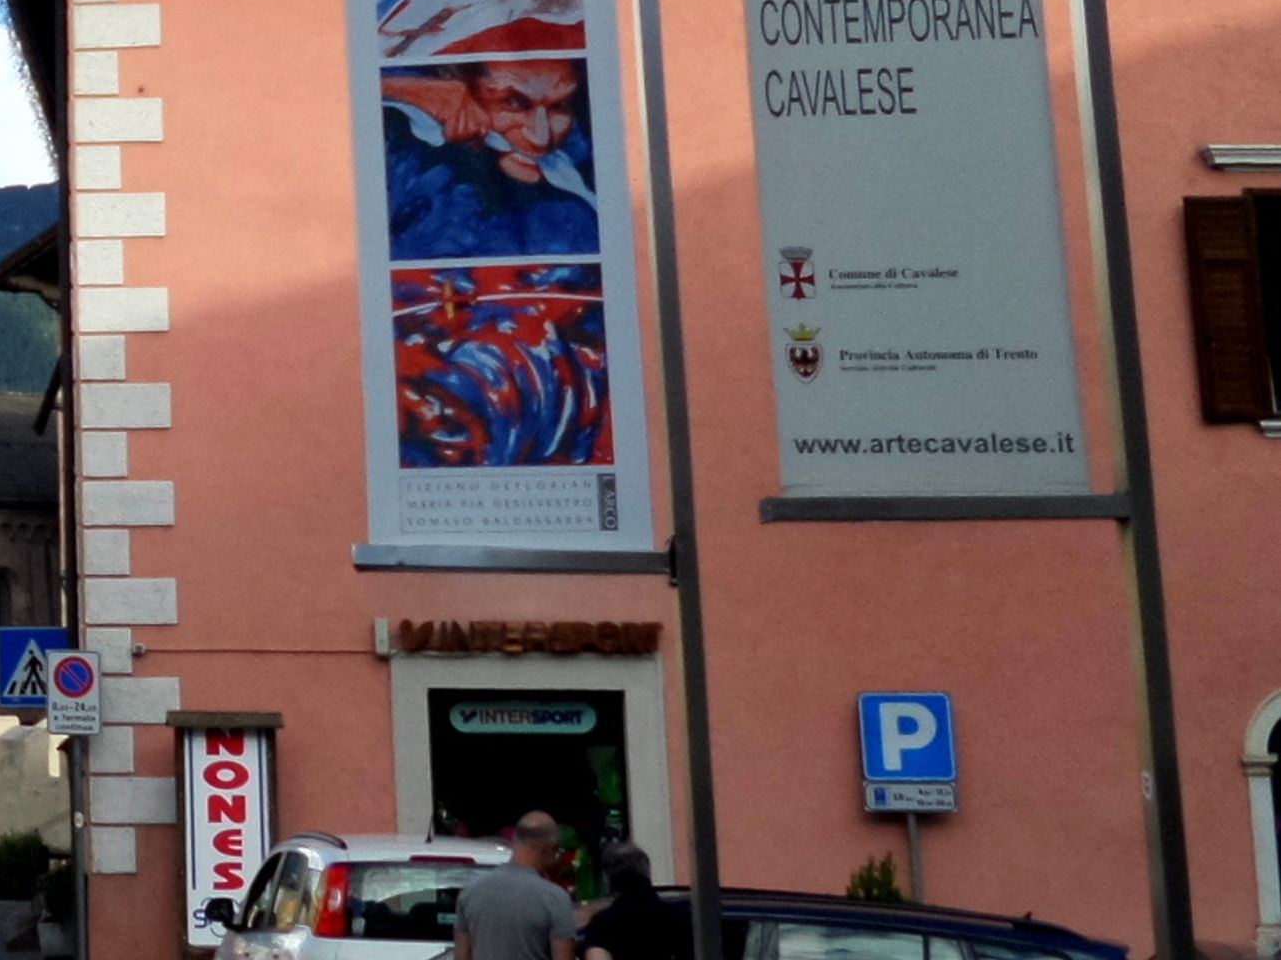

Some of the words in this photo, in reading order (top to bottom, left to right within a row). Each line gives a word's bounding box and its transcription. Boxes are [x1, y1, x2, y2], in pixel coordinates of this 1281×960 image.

[765, 67, 917, 117] CAVALESE
[828, 268, 882, 280] Comune
[885, 267, 898, 280] di
[901, 267, 959, 280] Cavalese
[839, 349, 899, 362] Provincia
[905, 349, 974, 361] Autonoma
[976, 348, 990, 361] di
[994, 349, 1038, 361] Trento
[794, 432, 1076, 455] www.artecavalese.it
[478, 708, 584, 726] INTERSPORT
[878, 701, 937, 772] P
[202, 727, 250, 891] NONES
